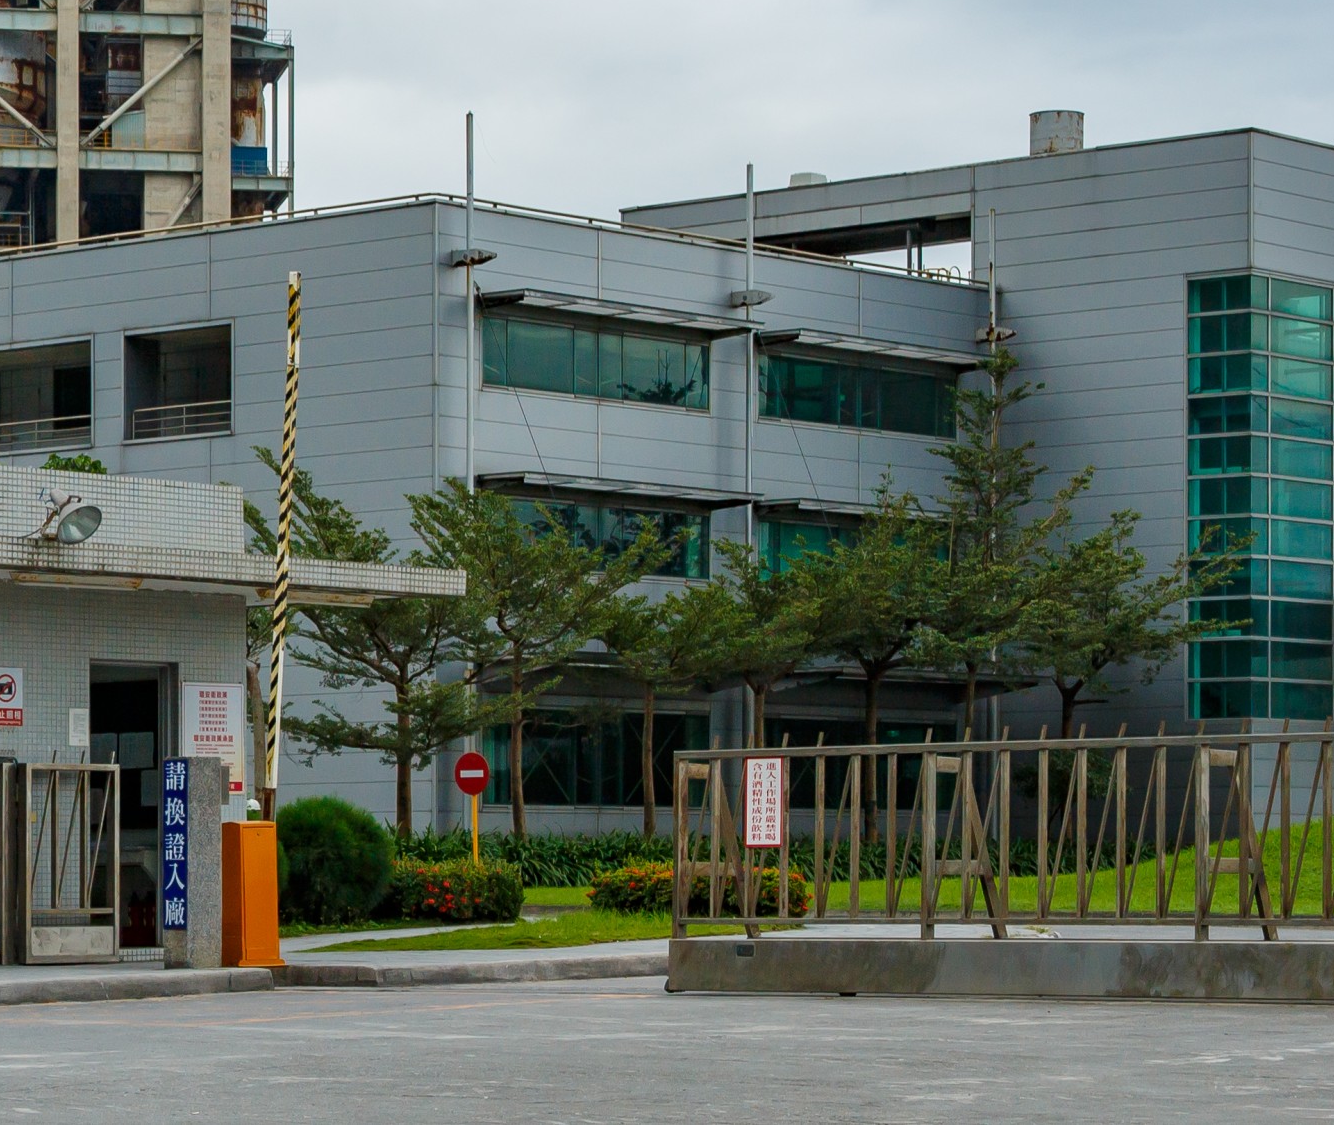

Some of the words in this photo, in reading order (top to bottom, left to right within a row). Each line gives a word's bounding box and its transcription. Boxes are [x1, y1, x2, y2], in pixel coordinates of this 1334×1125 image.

[165, 762, 185, 925] 請換證入廠
[751, 762, 763, 841] 含有酒精性成份飲料
